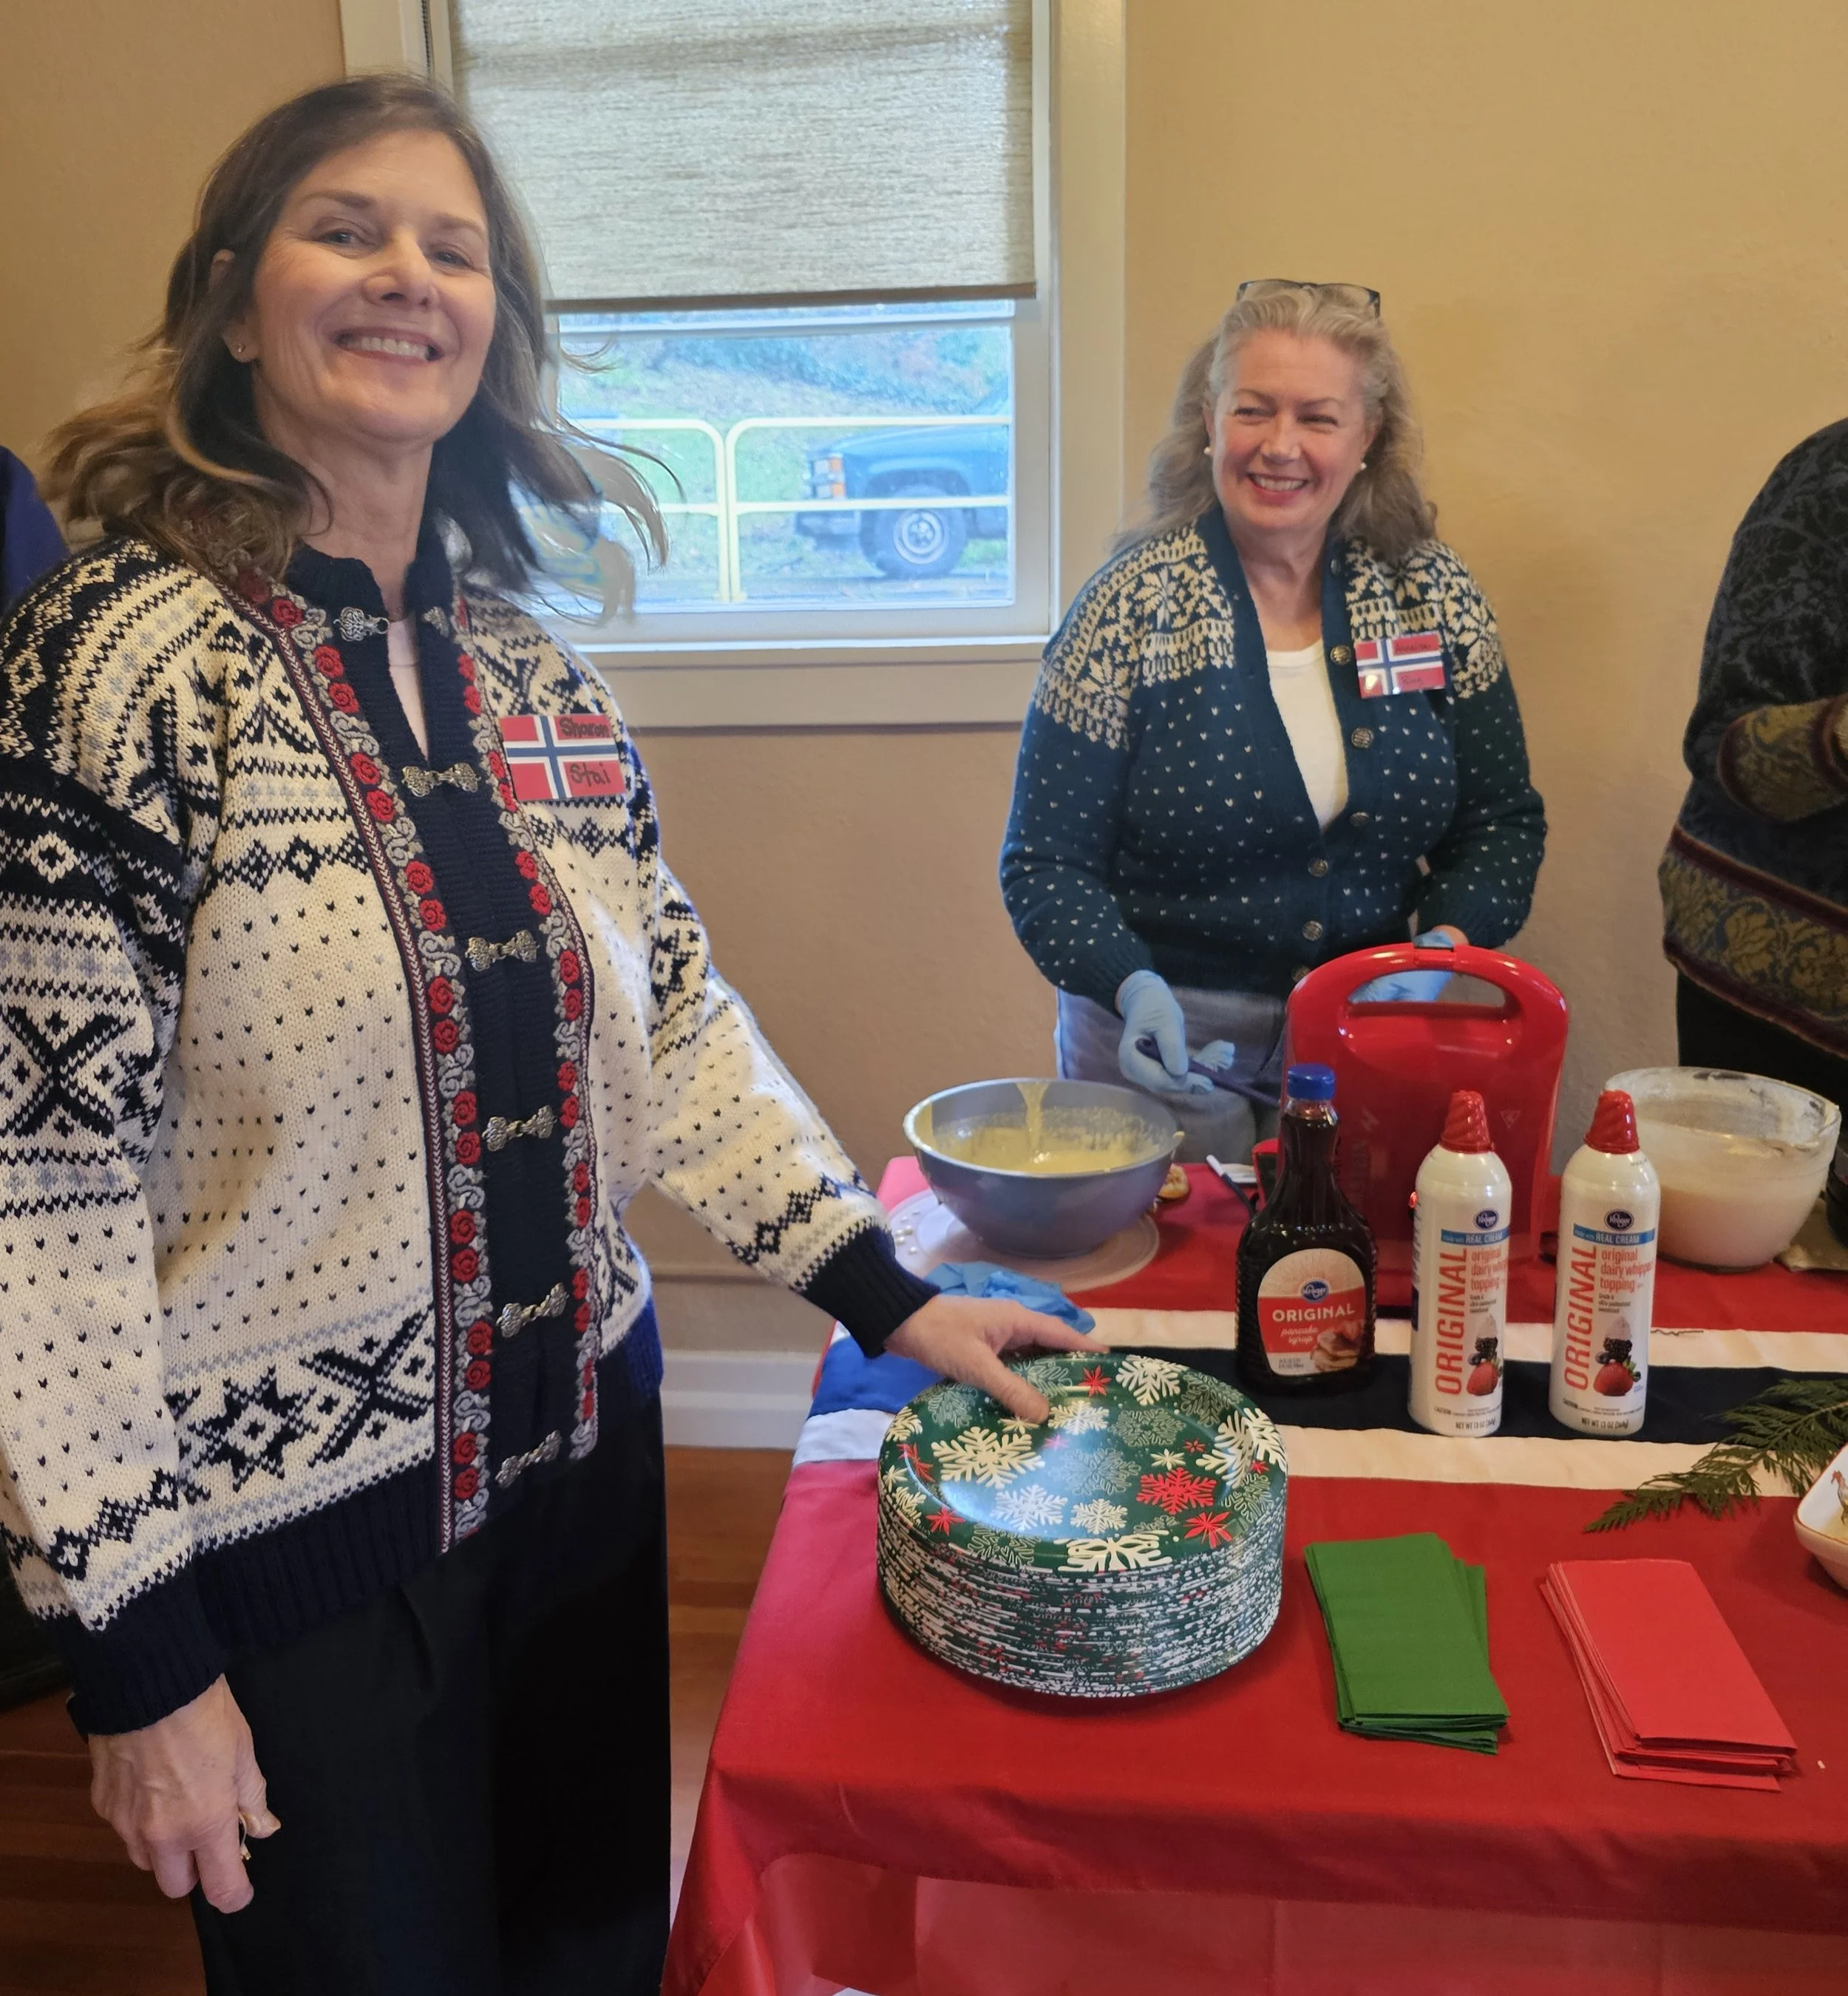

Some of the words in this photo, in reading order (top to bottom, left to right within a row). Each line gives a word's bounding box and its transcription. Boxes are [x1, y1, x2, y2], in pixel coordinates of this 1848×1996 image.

[1609, 1213, 1631, 1228] Kroger
[1466, 1235, 1483, 1244] REAL
[1484, 1232, 1503, 1243] CREAM
[1596, 1232, 1613, 1243] REAL
[1616, 1235, 1640, 1245] CREAM
[1472, 1246, 1501, 1263] original
[1602, 1249, 1638, 1265] original
[1472, 1263, 1492, 1277] dairy
[1601, 1263, 1624, 1279] dairy
[1302, 1284, 1327, 1298] Kroger
[1471, 1277, 1500, 1292] topping
[1600, 1278, 1635, 1294] topping
[1272, 1304, 1355, 1323] ORIGINAL
[1436, 1248, 1467, 1394] ORIGINAL
[1564, 1246, 1597, 1391] ORIGINAL
[1281, 1325, 1319, 1337] pancake
[1288, 1335, 1314, 1345] syrup
